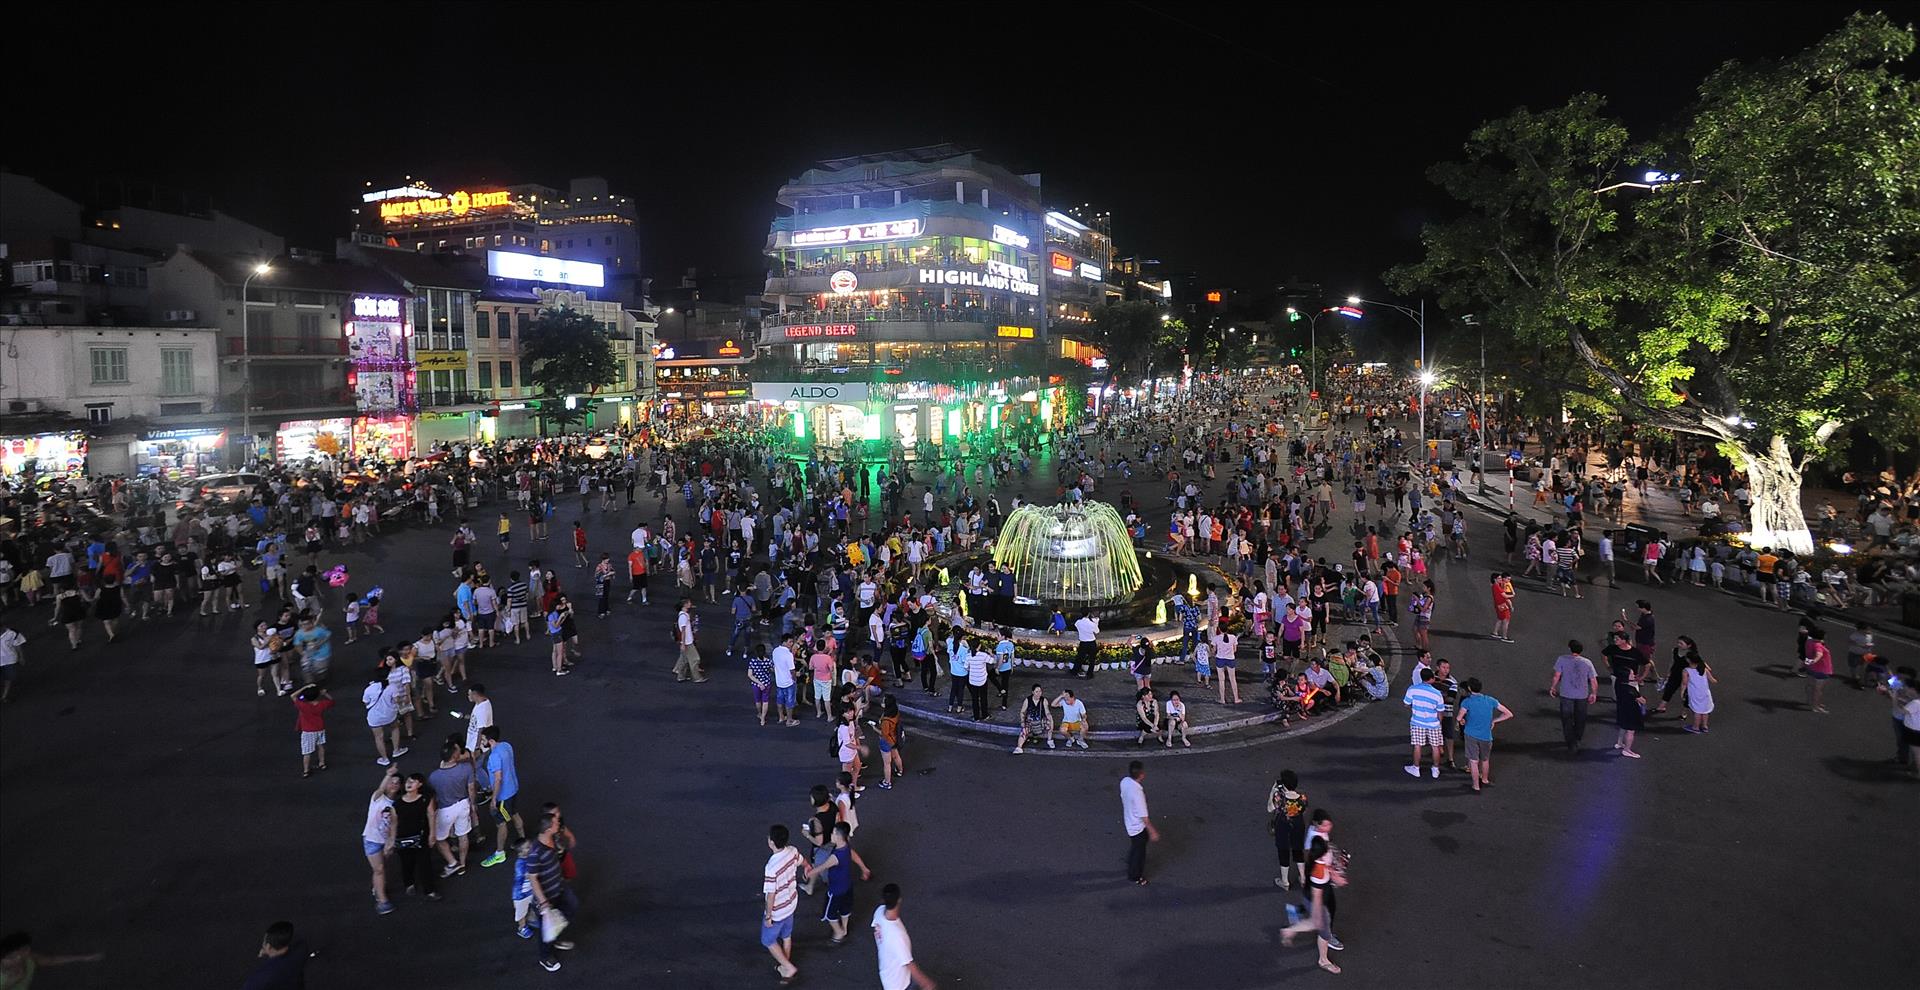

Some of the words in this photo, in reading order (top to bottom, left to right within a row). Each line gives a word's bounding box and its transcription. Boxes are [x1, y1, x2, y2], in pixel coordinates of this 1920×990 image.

[472, 191, 511, 208] HOTEL
[919, 268, 1010, 290] HIGHLANDS
[1011, 280, 1039, 297] COFFEE
[784, 325, 822, 337] LEGEND
[825, 324, 856, 336] BEER
[790, 387, 839, 398] ALDO
[147, 430, 176, 439] Vinh
